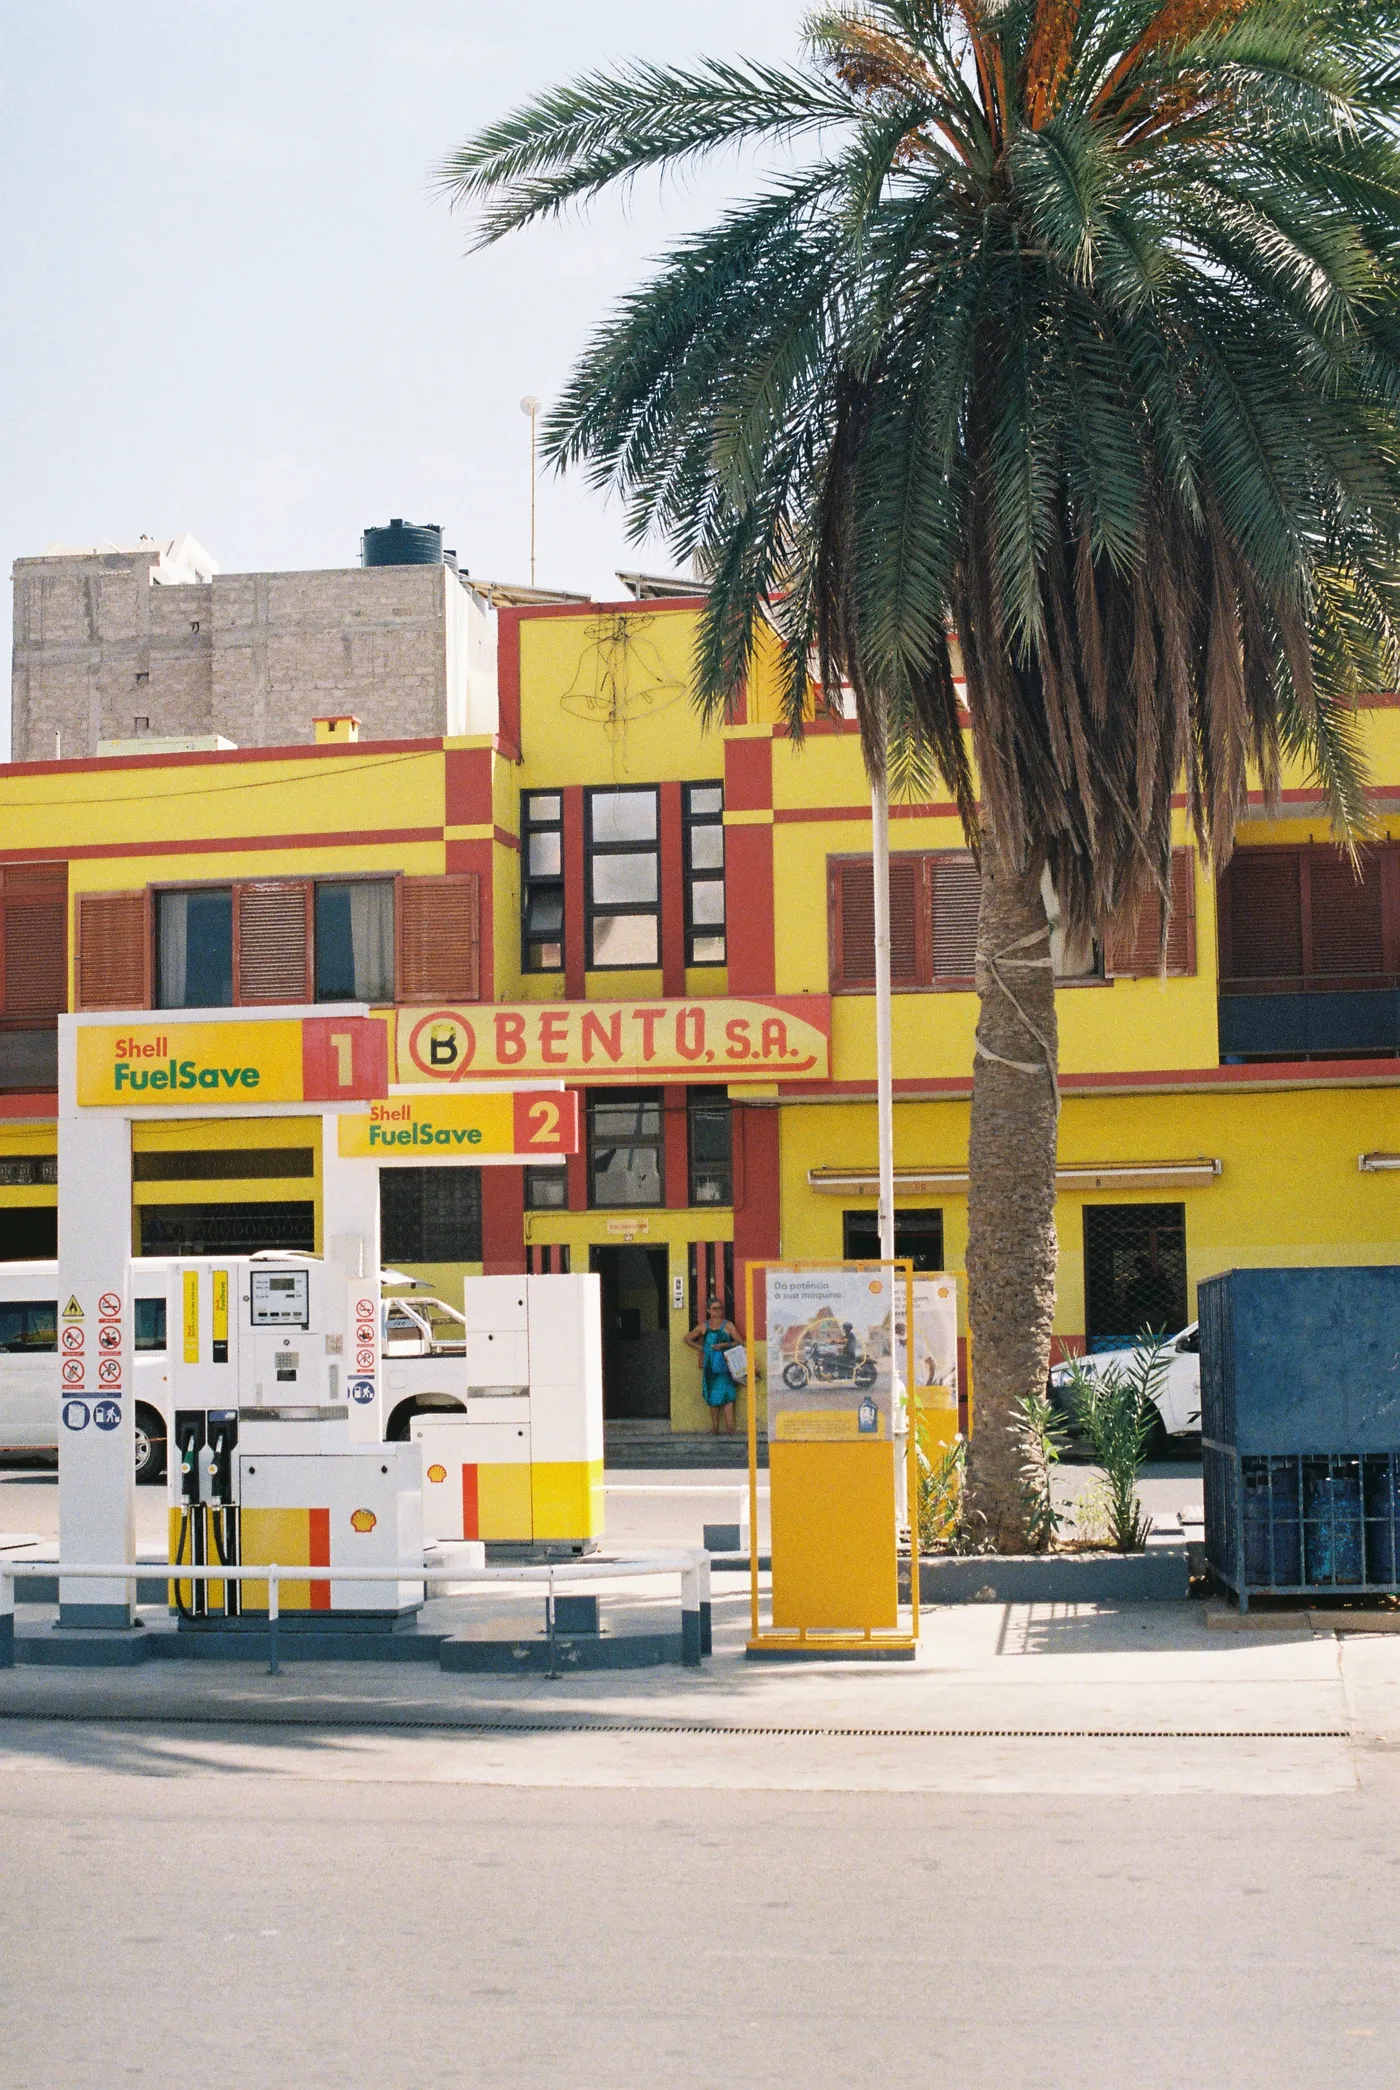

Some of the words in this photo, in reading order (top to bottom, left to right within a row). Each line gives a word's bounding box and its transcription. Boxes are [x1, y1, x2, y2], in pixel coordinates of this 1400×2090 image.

[114, 1036, 168, 1059] Shell
[494, 1006, 715, 1065] BENTO,
[724, 1017, 801, 1060] S.A.
[114, 1059, 261, 1091] FuelSave
[330, 1033, 353, 1087] 1
[369, 1104, 412, 1121] Shell
[528, 1100, 561, 1144] 2
[369, 1122, 483, 1146] FuelSave
